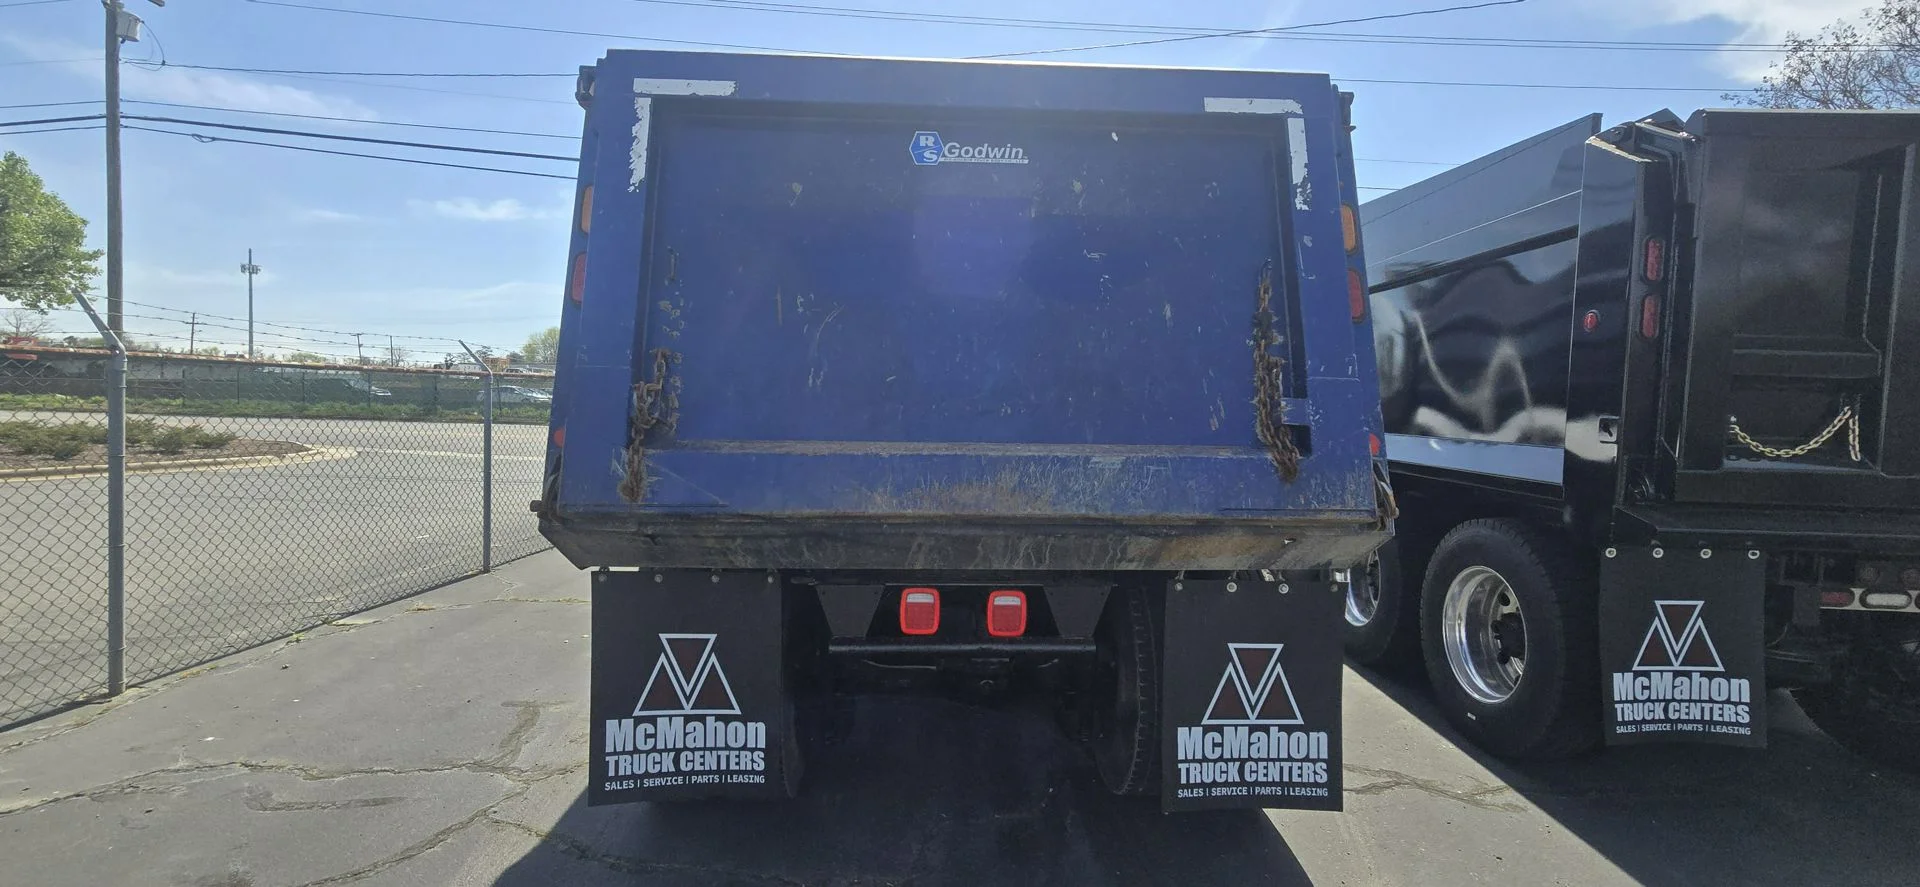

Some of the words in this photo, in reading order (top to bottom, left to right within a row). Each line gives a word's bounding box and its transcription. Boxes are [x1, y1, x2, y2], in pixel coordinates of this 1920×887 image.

[919, 135, 935, 147] R
[944, 142, 1024, 159] Godwin
[923, 149, 938, 162] S
[1613, 672, 1750, 703] McMahon
[1614, 702, 1665, 721] TRUCK
[1668, 702, 1750, 723] CENTERS
[605, 716, 766, 752] McMahon
[1616, 725, 1636, 733] SALES
[1641, 723, 1671, 732] SERVICE
[1677, 723, 1703, 731] PARTS
[1711, 725, 1751, 735] LEASING
[1177, 726, 1328, 760] McMahon
[605, 751, 676, 777] TRUCK
[679, 750, 765, 771] CENTERS
[1178, 762, 1240, 784] TRUCK
[1244, 761, 1328, 783] CENTERS
[604, 780, 634, 791] SALES
[643, 776, 683, 787] SERVICE
[692, 775, 719, 784] PARTS
[727, 774, 765, 784] LEASING
[1178, 788, 1203, 798] SALES
[1211, 787, 1248, 796] SERVICE
[1255, 787, 1282, 795] PARTS
[1290, 787, 1328, 797] LEASING
